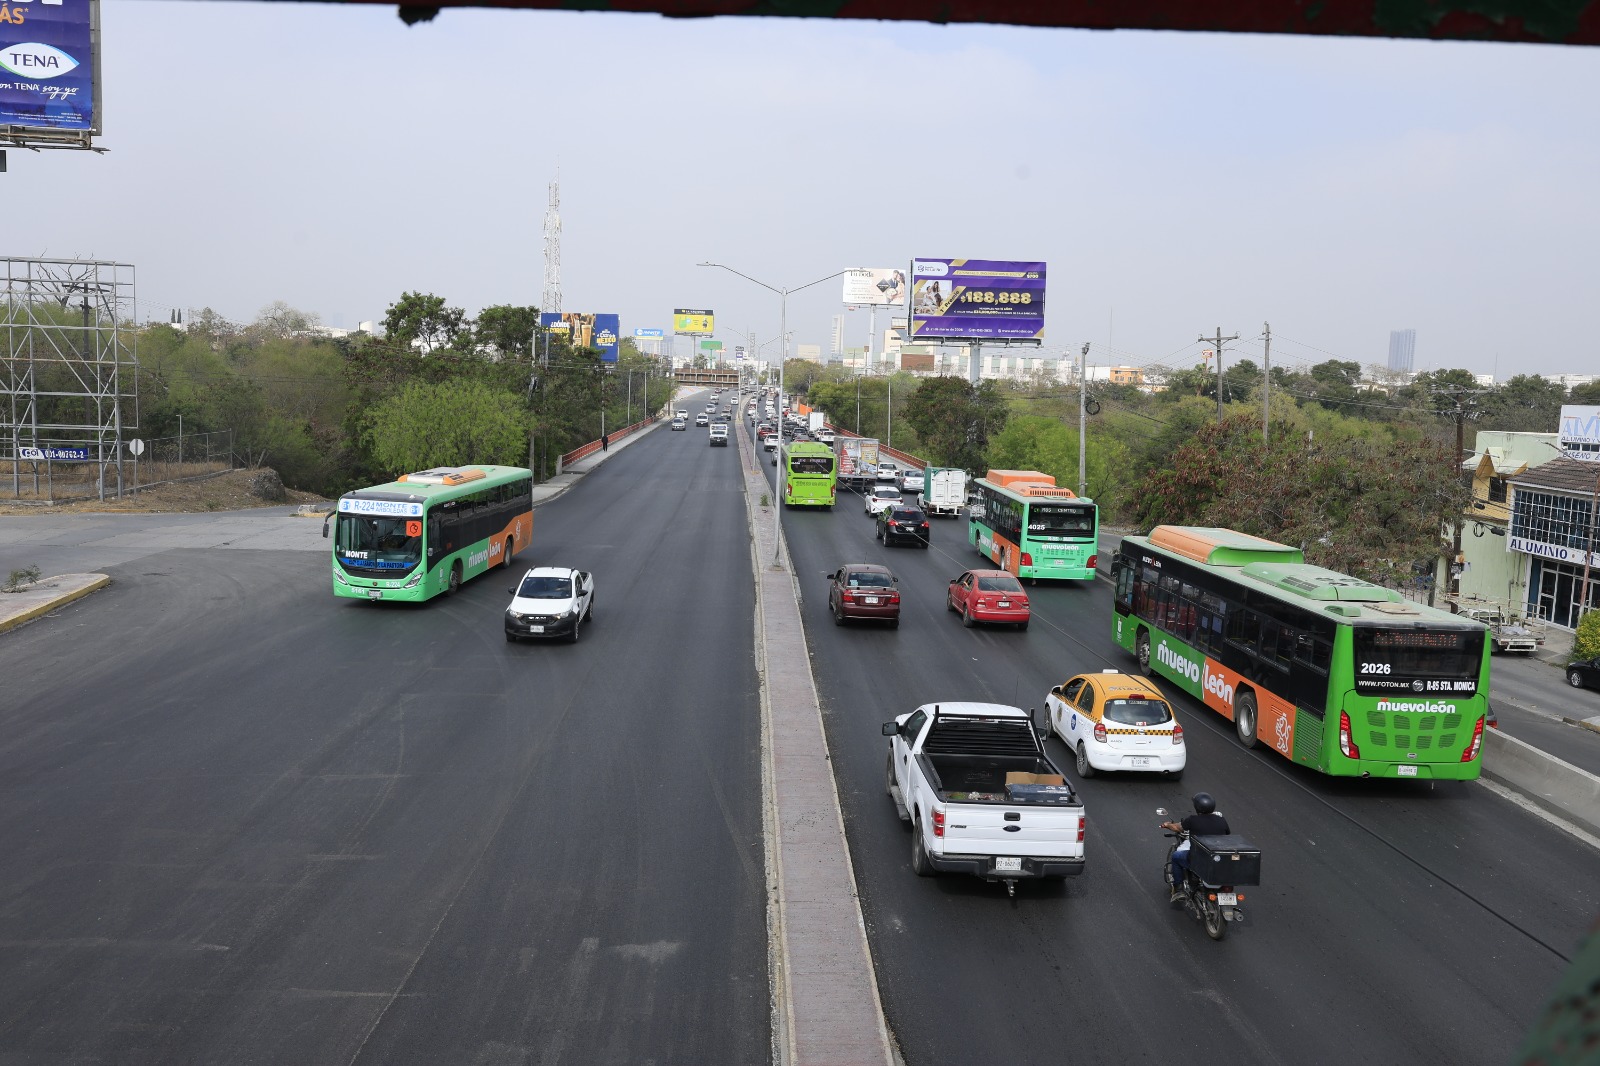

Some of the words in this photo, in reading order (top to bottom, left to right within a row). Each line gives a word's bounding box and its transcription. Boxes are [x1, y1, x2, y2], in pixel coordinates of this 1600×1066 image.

[9, 52, 59, 69] TENA
[14, 82, 40, 91] TENA
[960, 291, 1032, 306] $188,888
[354, 501, 375, 511] R-224
[345, 550, 369, 559] MONTE
[1510, 538, 1568, 560] ALUMINIO
[1157, 639, 1200, 683] muevo
[1203, 664, 1234, 706] león
[1361, 662, 1391, 675] 2026
[1358, 680, 1410, 688] WWW.FOTON.MX
[1376, 701, 1456, 713] muevoleón
